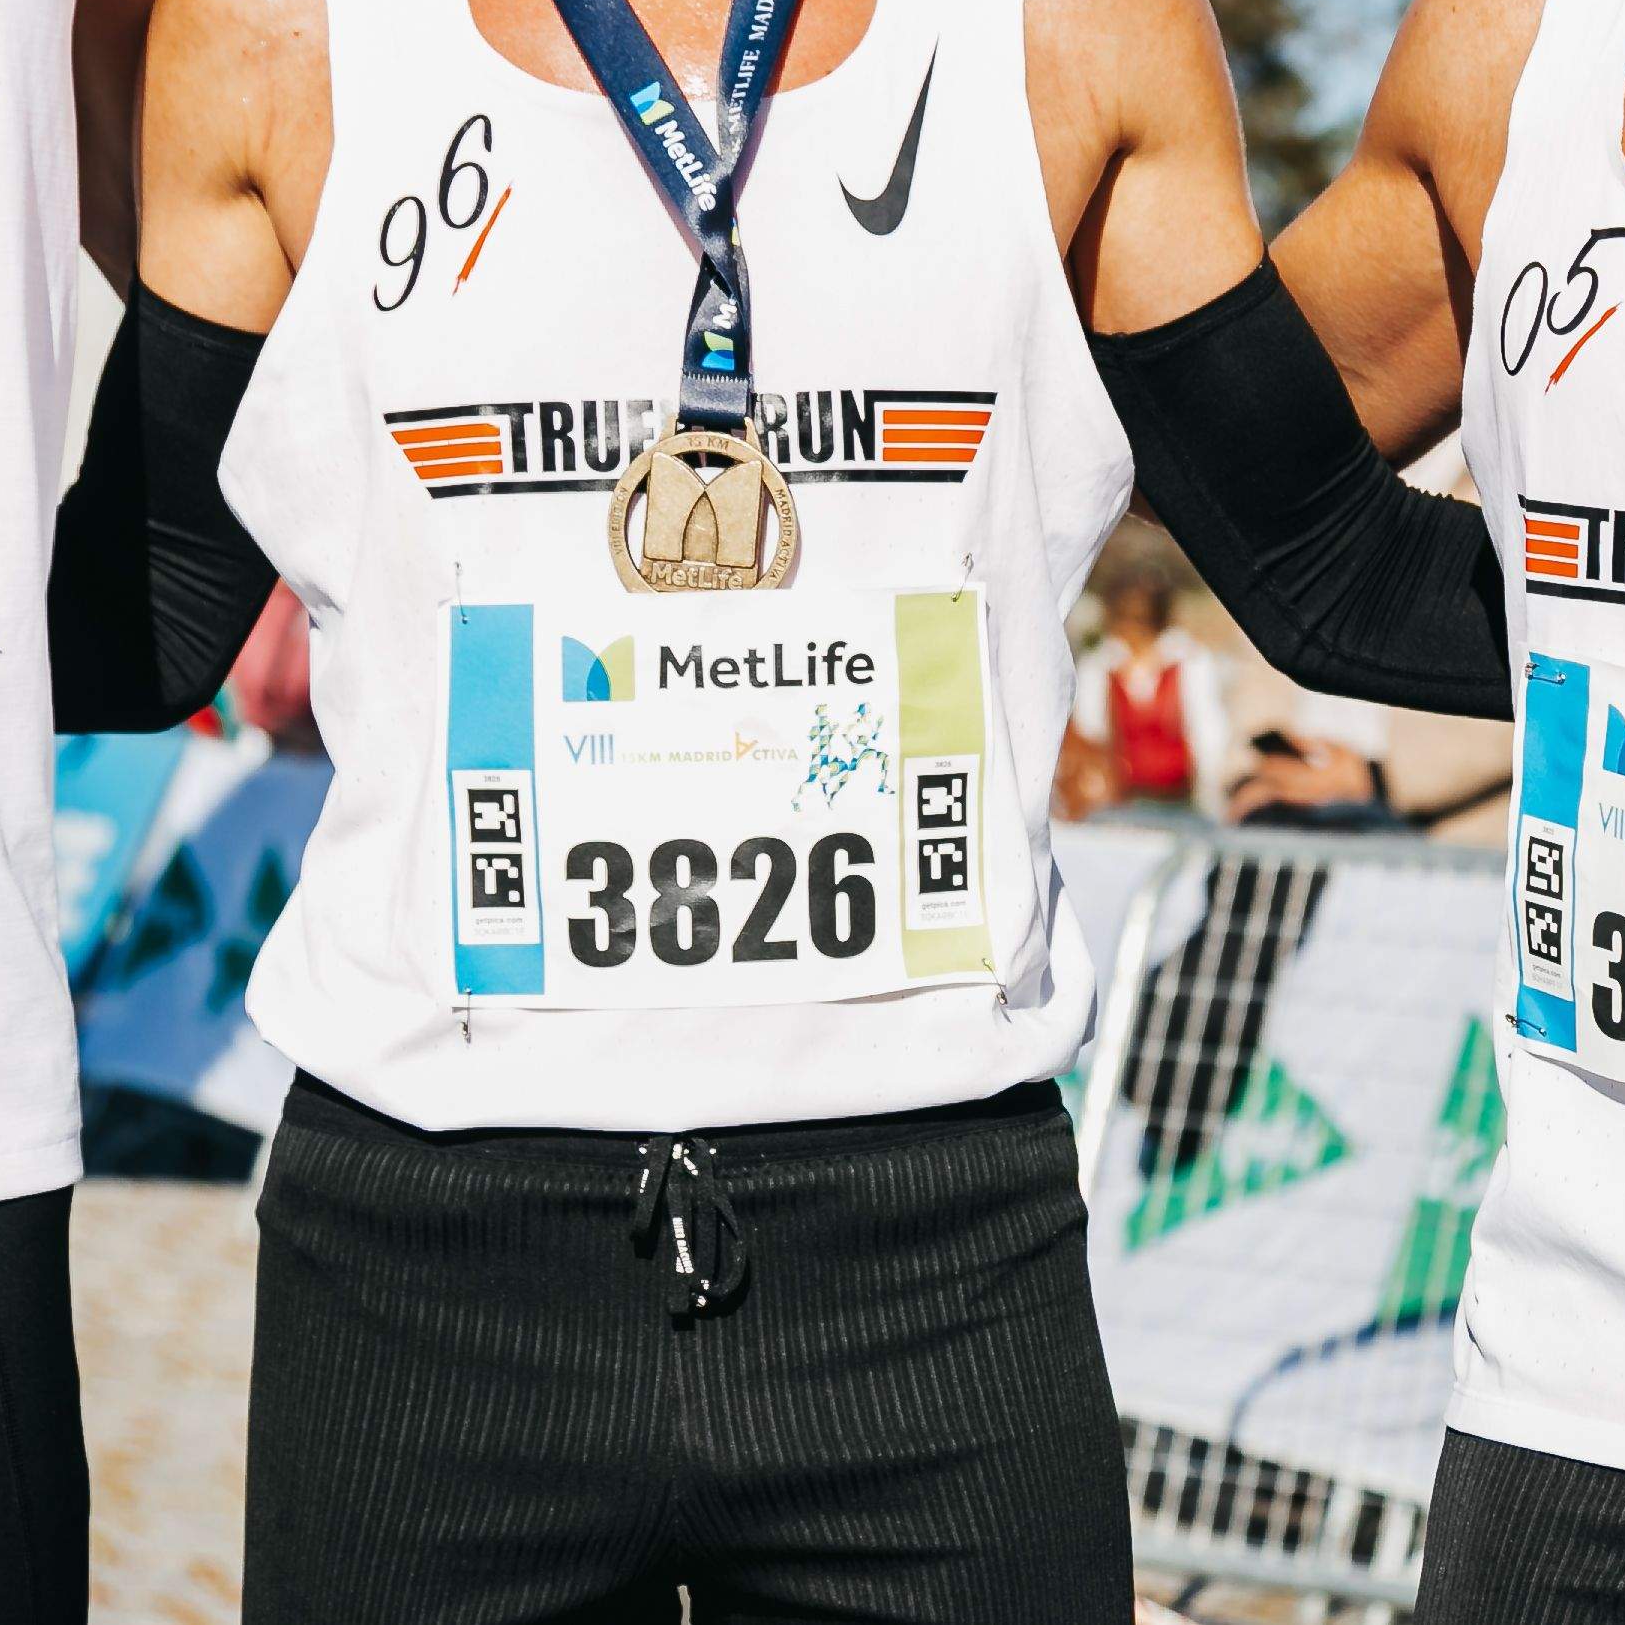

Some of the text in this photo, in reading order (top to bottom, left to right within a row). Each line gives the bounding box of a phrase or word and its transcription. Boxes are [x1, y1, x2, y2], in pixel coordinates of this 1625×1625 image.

[727, 49, 760, 135] METLIFE
[655, 119, 717, 212] MetLife
[373, 113, 493, 312] 96
[504, 388, 876, 474] TRUE RUN
[775, 488, 793, 537] MADRID
[650, 562, 744, 590] MetLife
[658, 639, 876, 690] MetLife
[563, 733, 614, 765] VIII
[668, 750, 732, 763] MADRID
[565, 832, 877, 968] 3826
